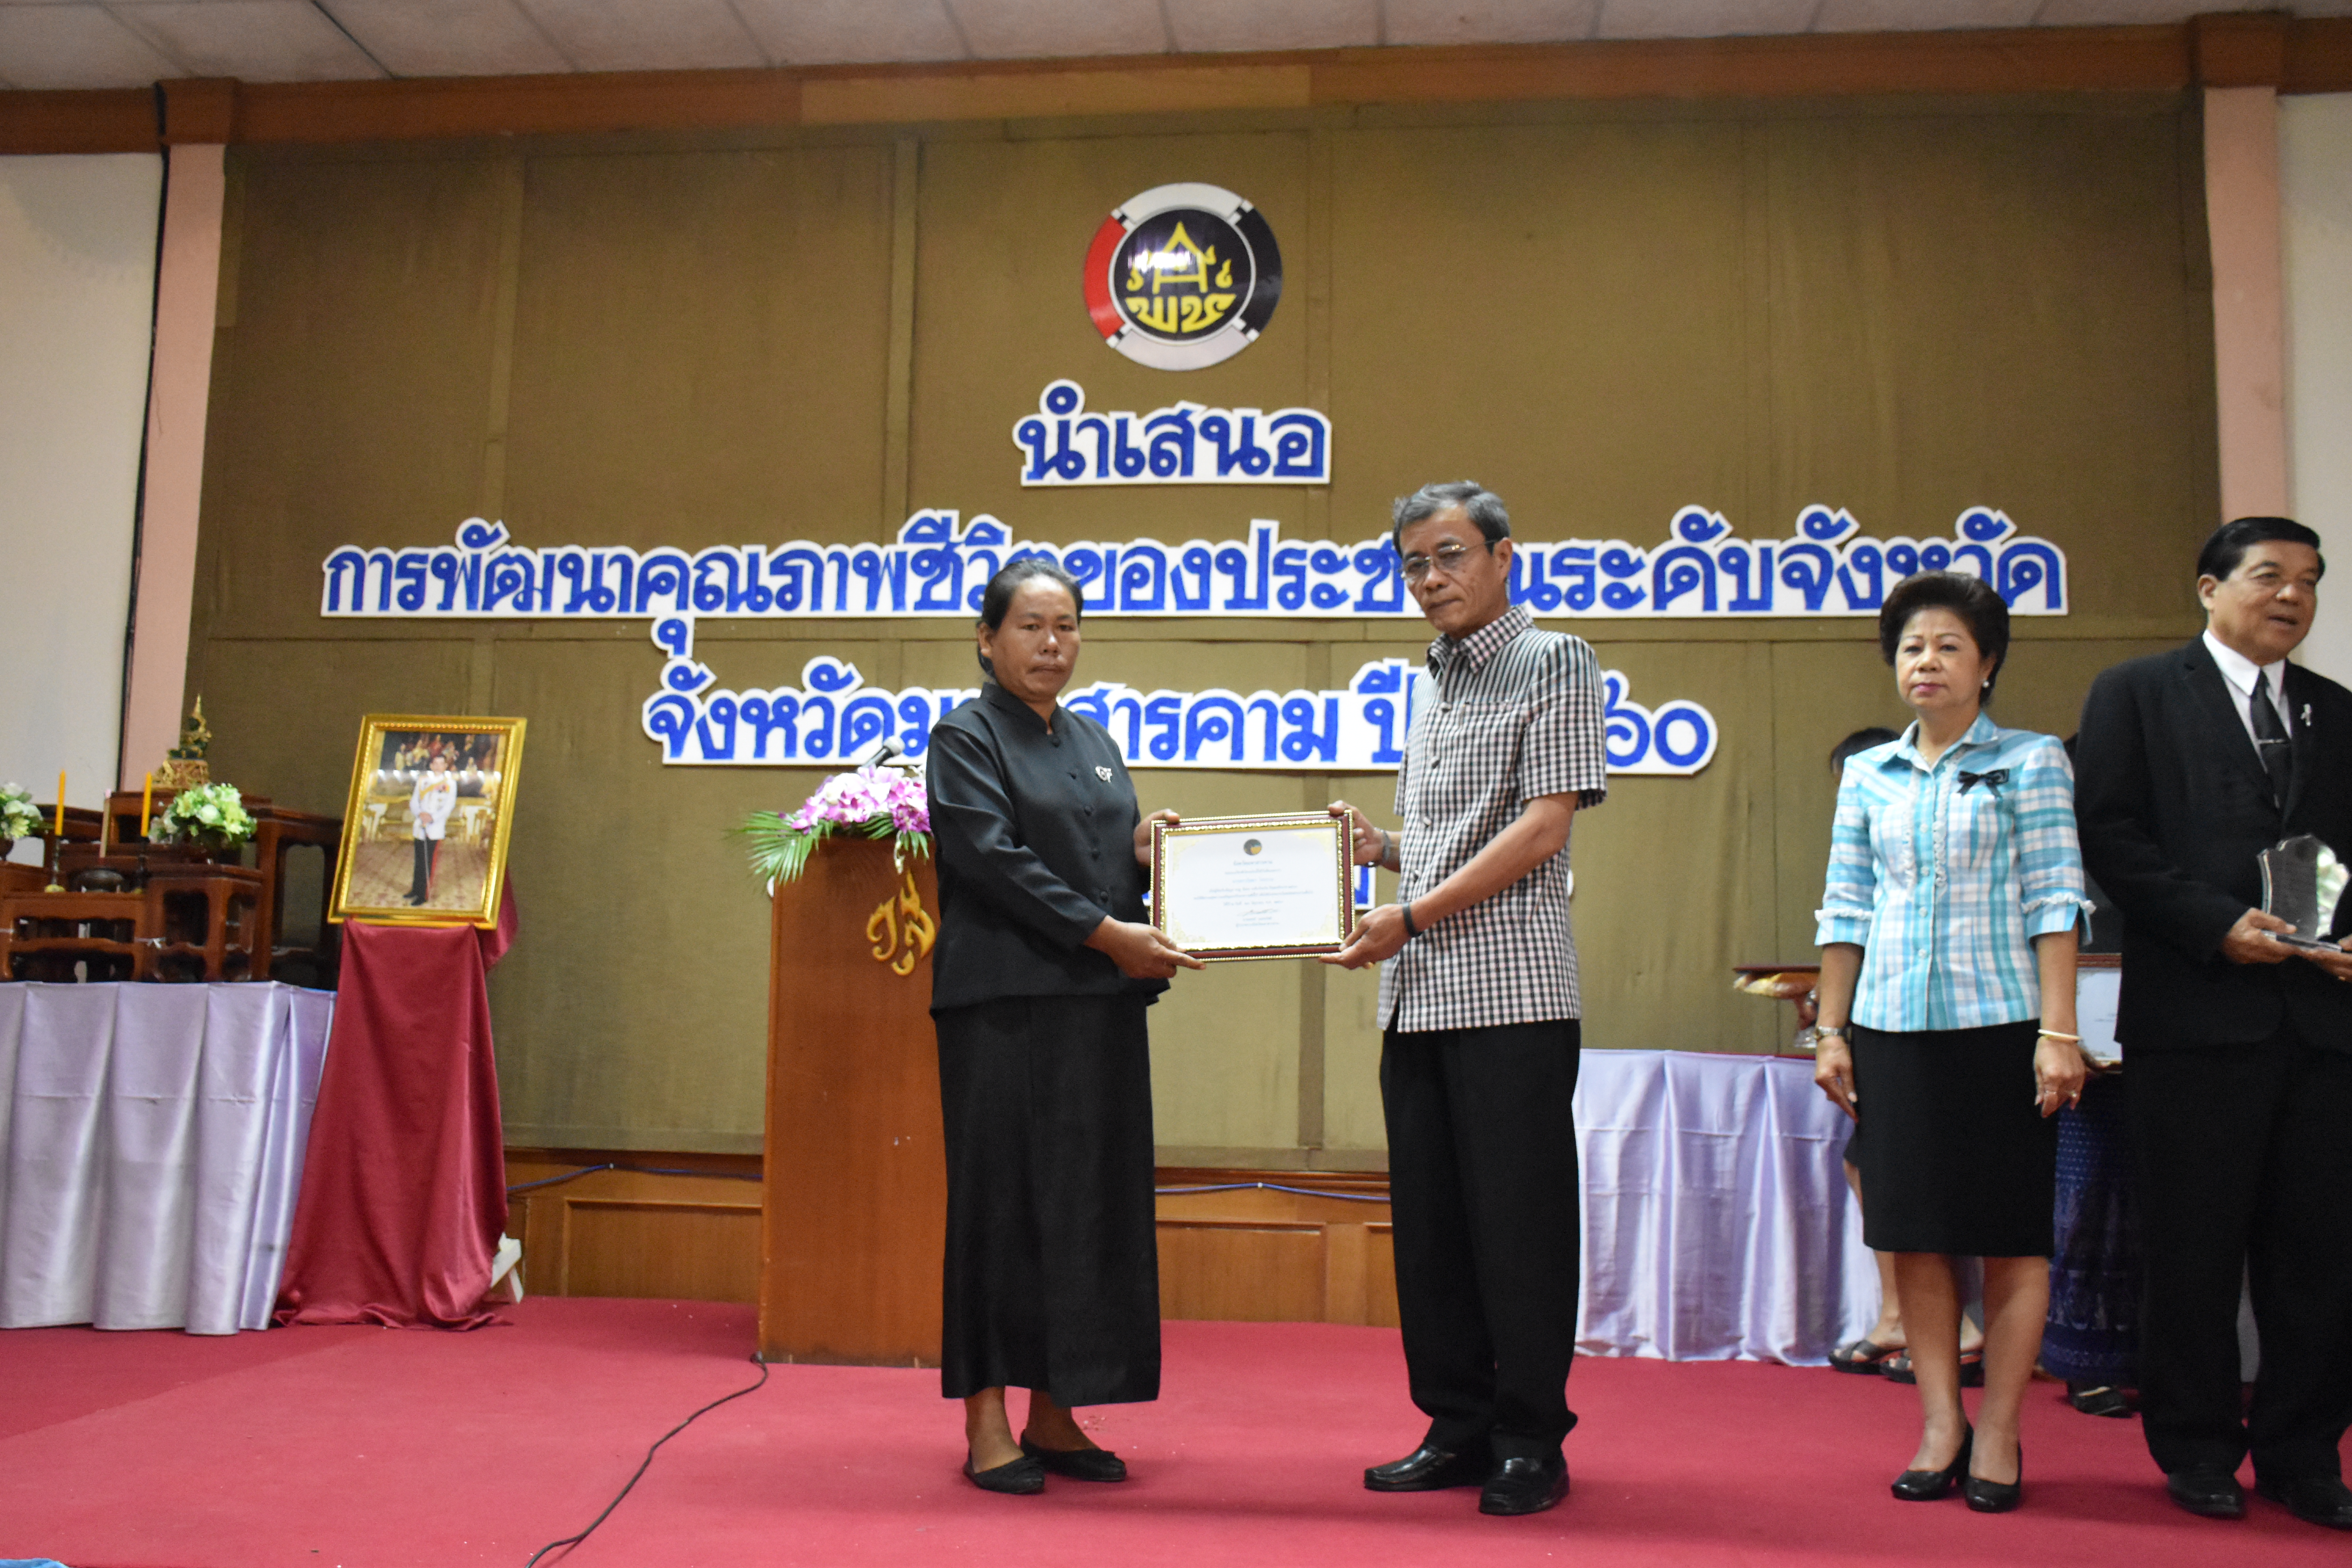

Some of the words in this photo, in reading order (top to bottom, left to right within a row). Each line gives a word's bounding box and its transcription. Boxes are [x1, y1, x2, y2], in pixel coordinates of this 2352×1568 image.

[1018, 386, 1325, 481] นำเสนอ
[1357, 665, 1417, 764] ปี
